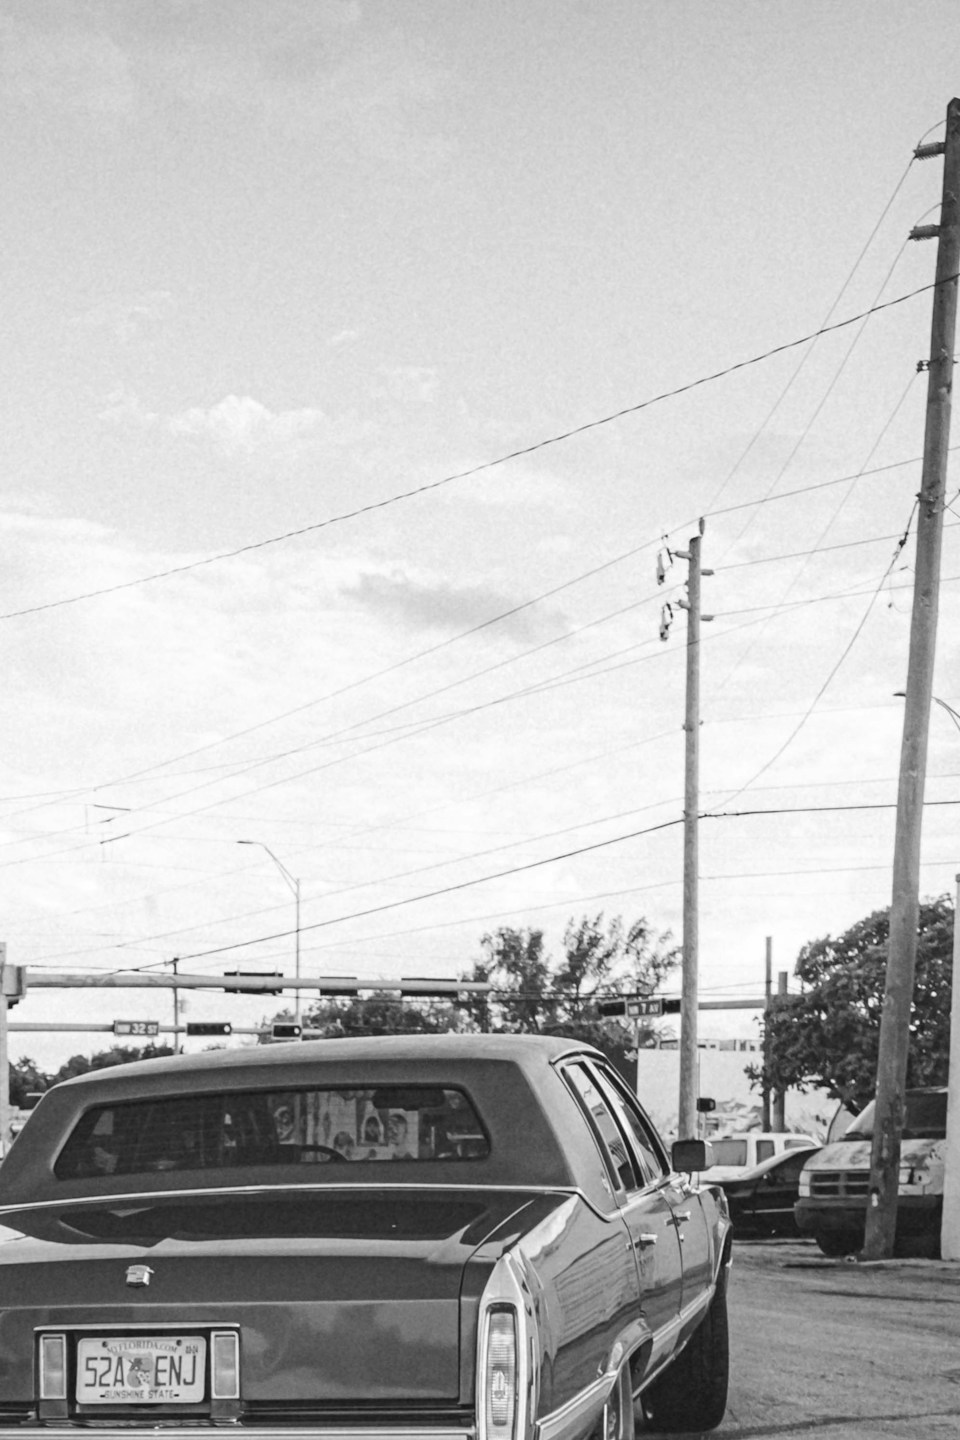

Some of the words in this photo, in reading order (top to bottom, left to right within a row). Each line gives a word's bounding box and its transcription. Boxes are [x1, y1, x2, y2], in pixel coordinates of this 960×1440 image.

[131, 1022, 147, 1034] 32
[85, 1356, 125, 1388] 52A
[154, 1355, 196, 1387] ENJ
[104, 1389, 145, 1399] SUNSHINE
[148, 1389, 174, 1399] STATE
